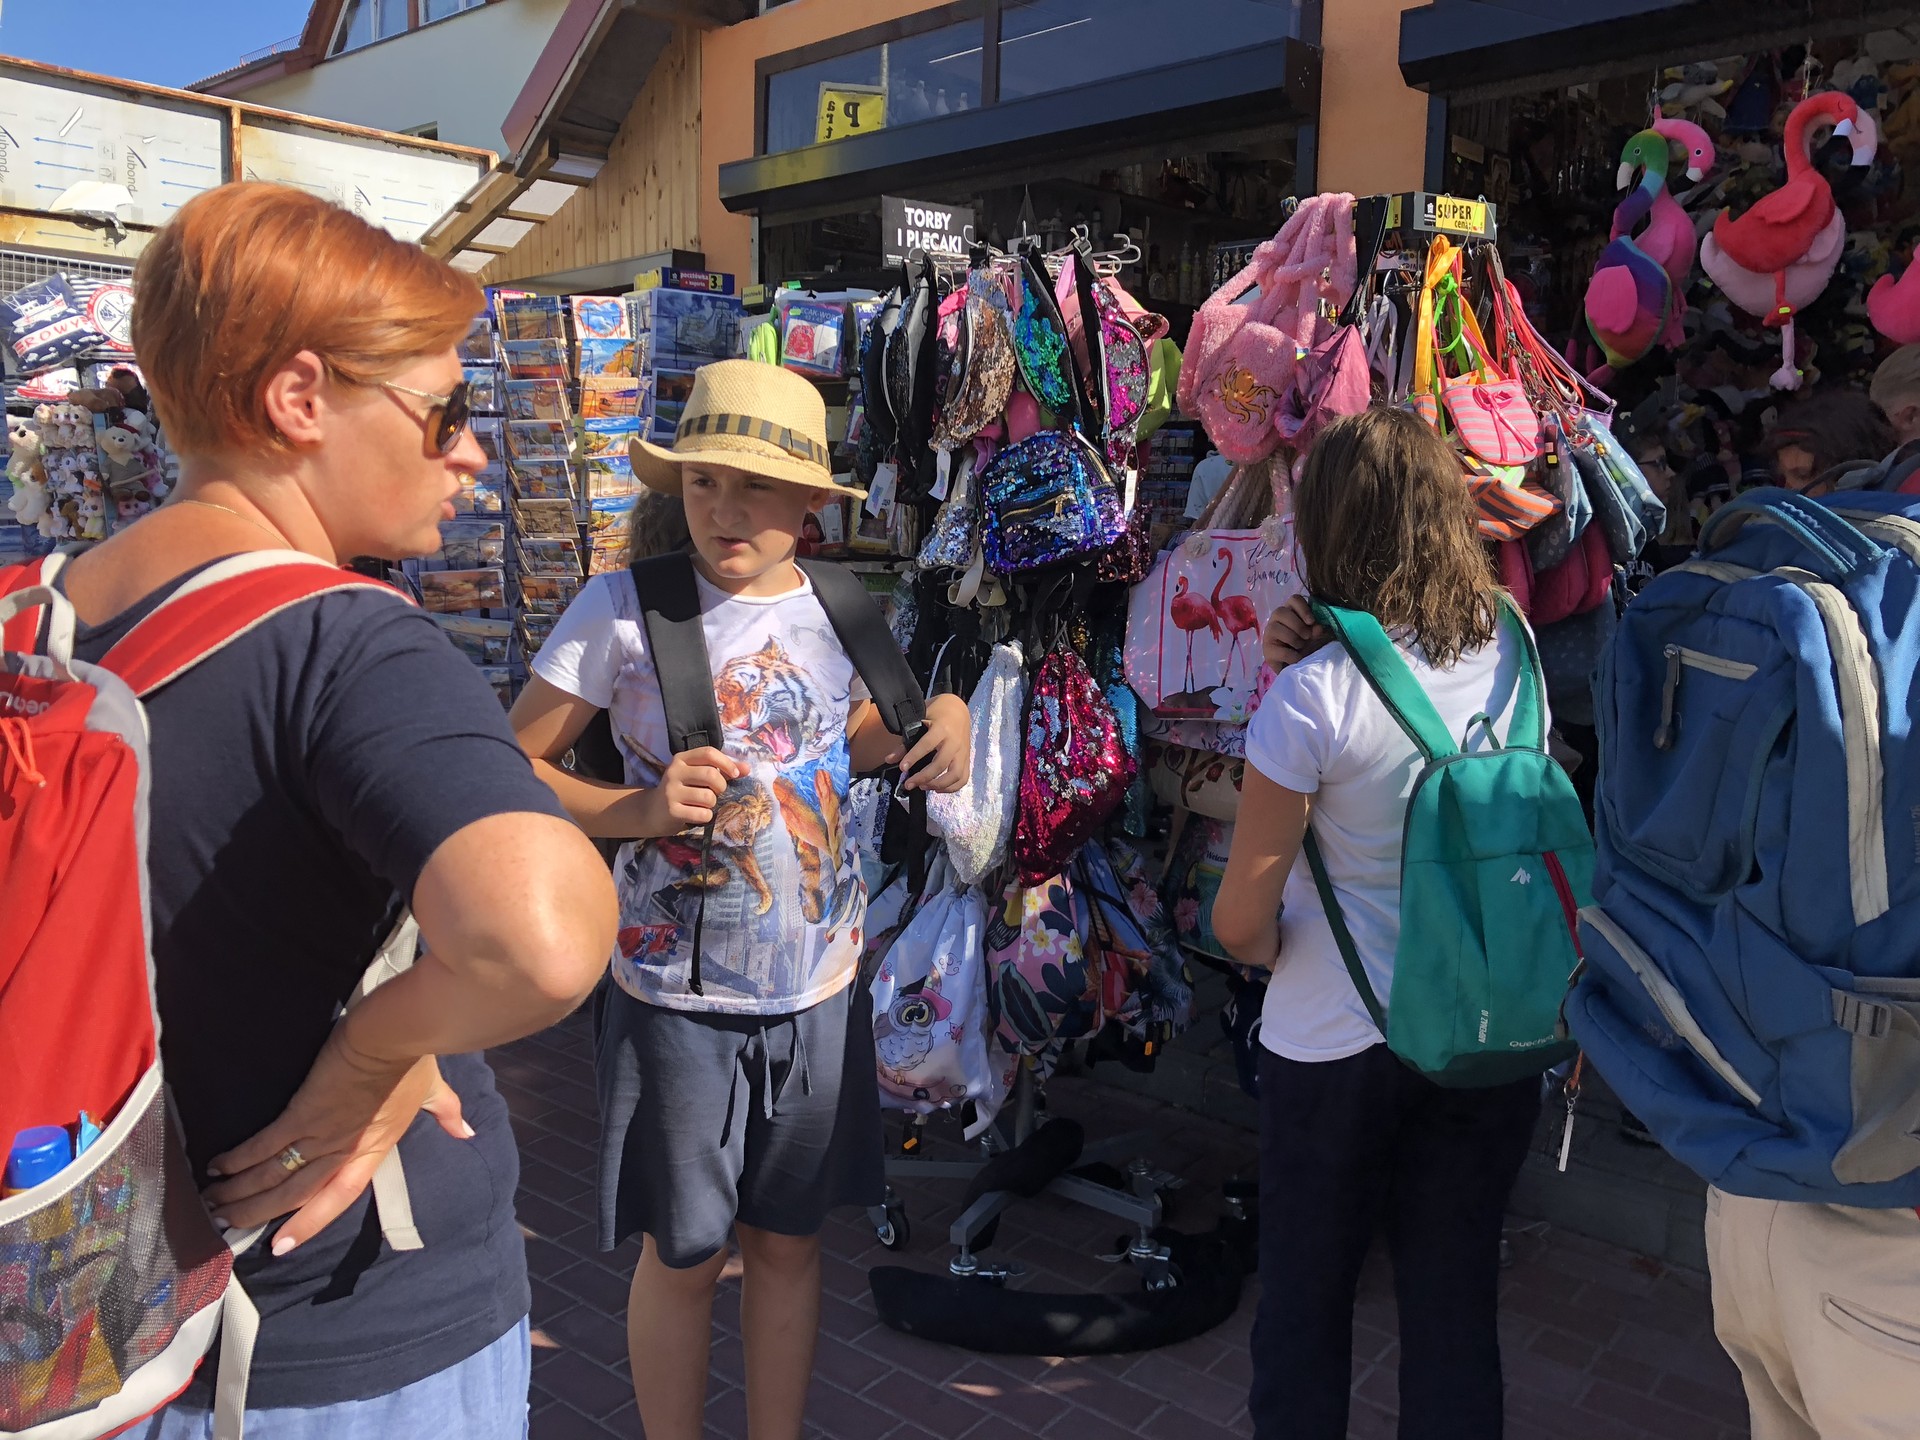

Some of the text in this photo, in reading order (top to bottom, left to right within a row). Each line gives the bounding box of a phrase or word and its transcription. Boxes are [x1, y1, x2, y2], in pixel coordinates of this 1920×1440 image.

[904, 206, 951, 230] TORBY
[1438, 204, 1472, 219] SUPER
[897, 227, 962, 254] I PLECAKI
